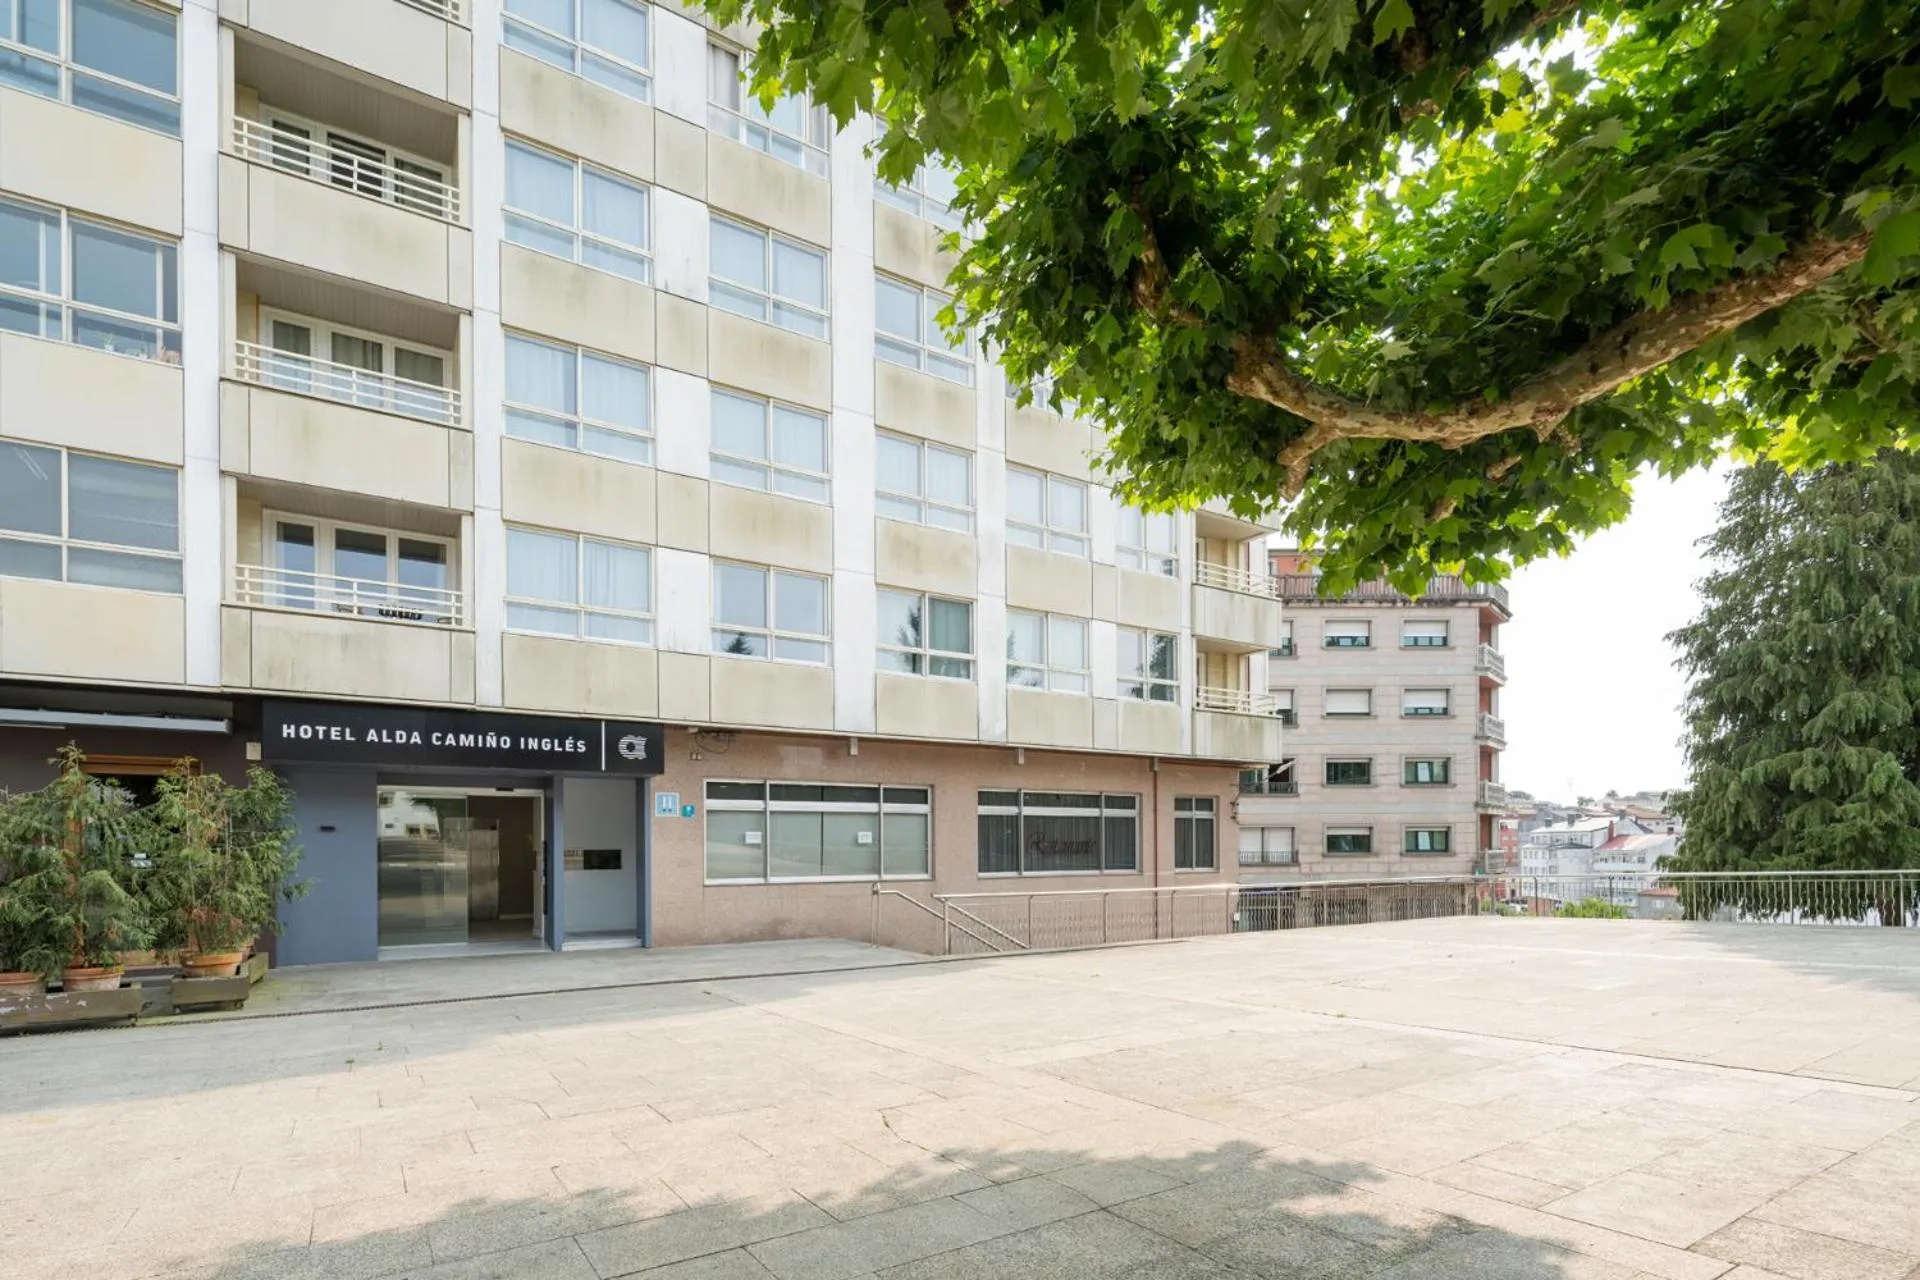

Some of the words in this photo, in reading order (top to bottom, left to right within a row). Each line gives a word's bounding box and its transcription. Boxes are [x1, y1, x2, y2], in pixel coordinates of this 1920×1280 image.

[282, 723, 356, 741] HOTEL
[366, 728, 422, 745] ALDA
[431, 731, 511, 749] CAMIÑO
[520, 736, 586, 753] INGLÉS
